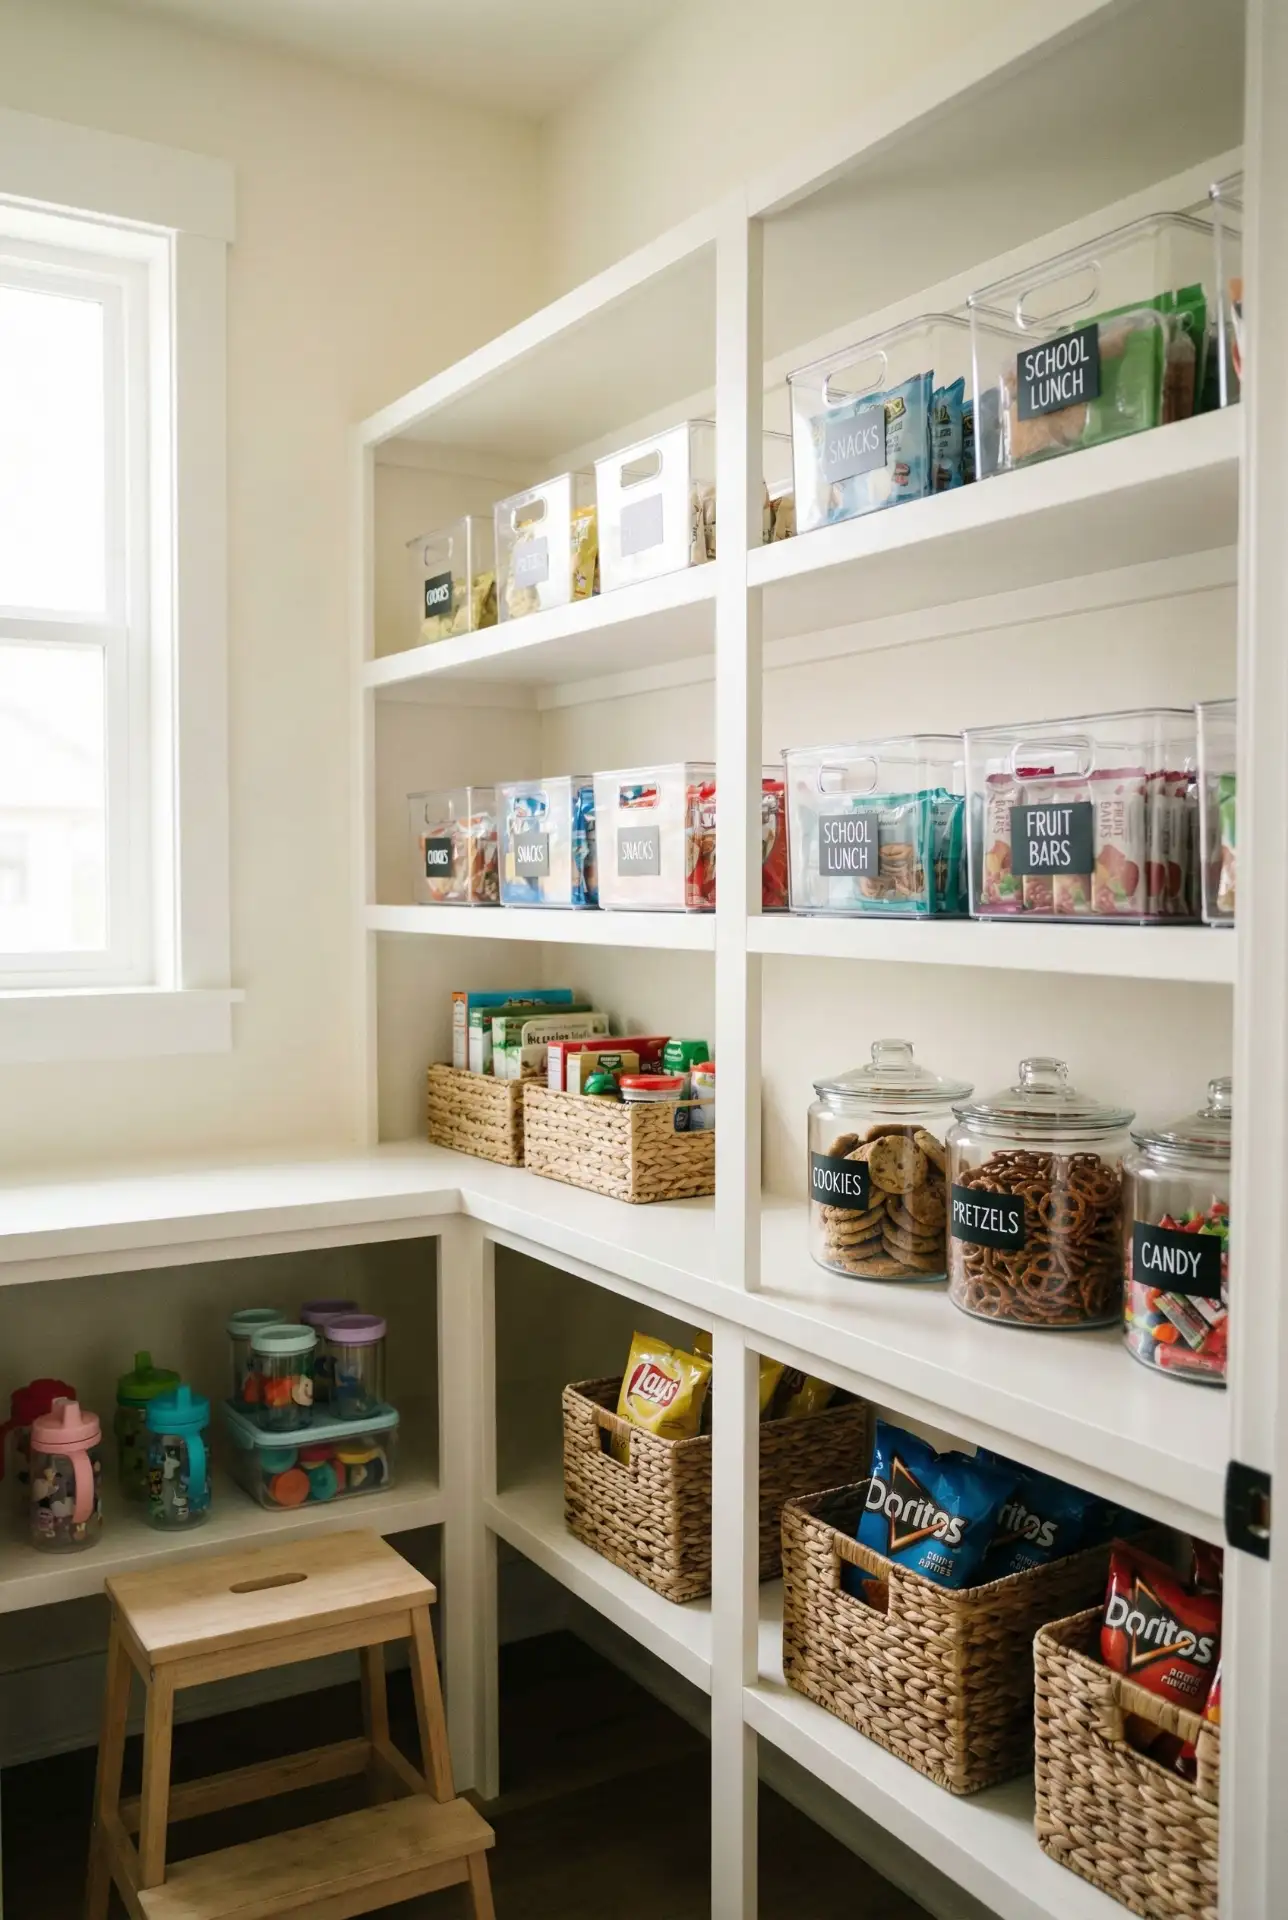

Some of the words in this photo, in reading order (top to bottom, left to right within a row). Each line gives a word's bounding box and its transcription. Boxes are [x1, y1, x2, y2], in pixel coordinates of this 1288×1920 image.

[1025, 335, 1090, 381] SCHOOL
[1031, 368, 1084, 410] LUNCH
[829, 424, 880, 464] SNACKS
[824, 820, 871, 844] SCHOOL
[1026, 809, 1073, 837] FRUIT
[517, 844, 544, 863] SNACKS
[621, 840, 654, 861] SNACKS
[828, 846, 868, 870] LUNCH
[1029, 839, 1072, 867] BARS
[813, 1166, 862, 1196] COOKIES
[953, 1199, 1019, 1234] PRETZELS
[1141, 1241, 1202, 1278] CANDY
[865, 1477, 966, 1544] Doritos
[1105, 1595, 1215, 1664] Doritos
